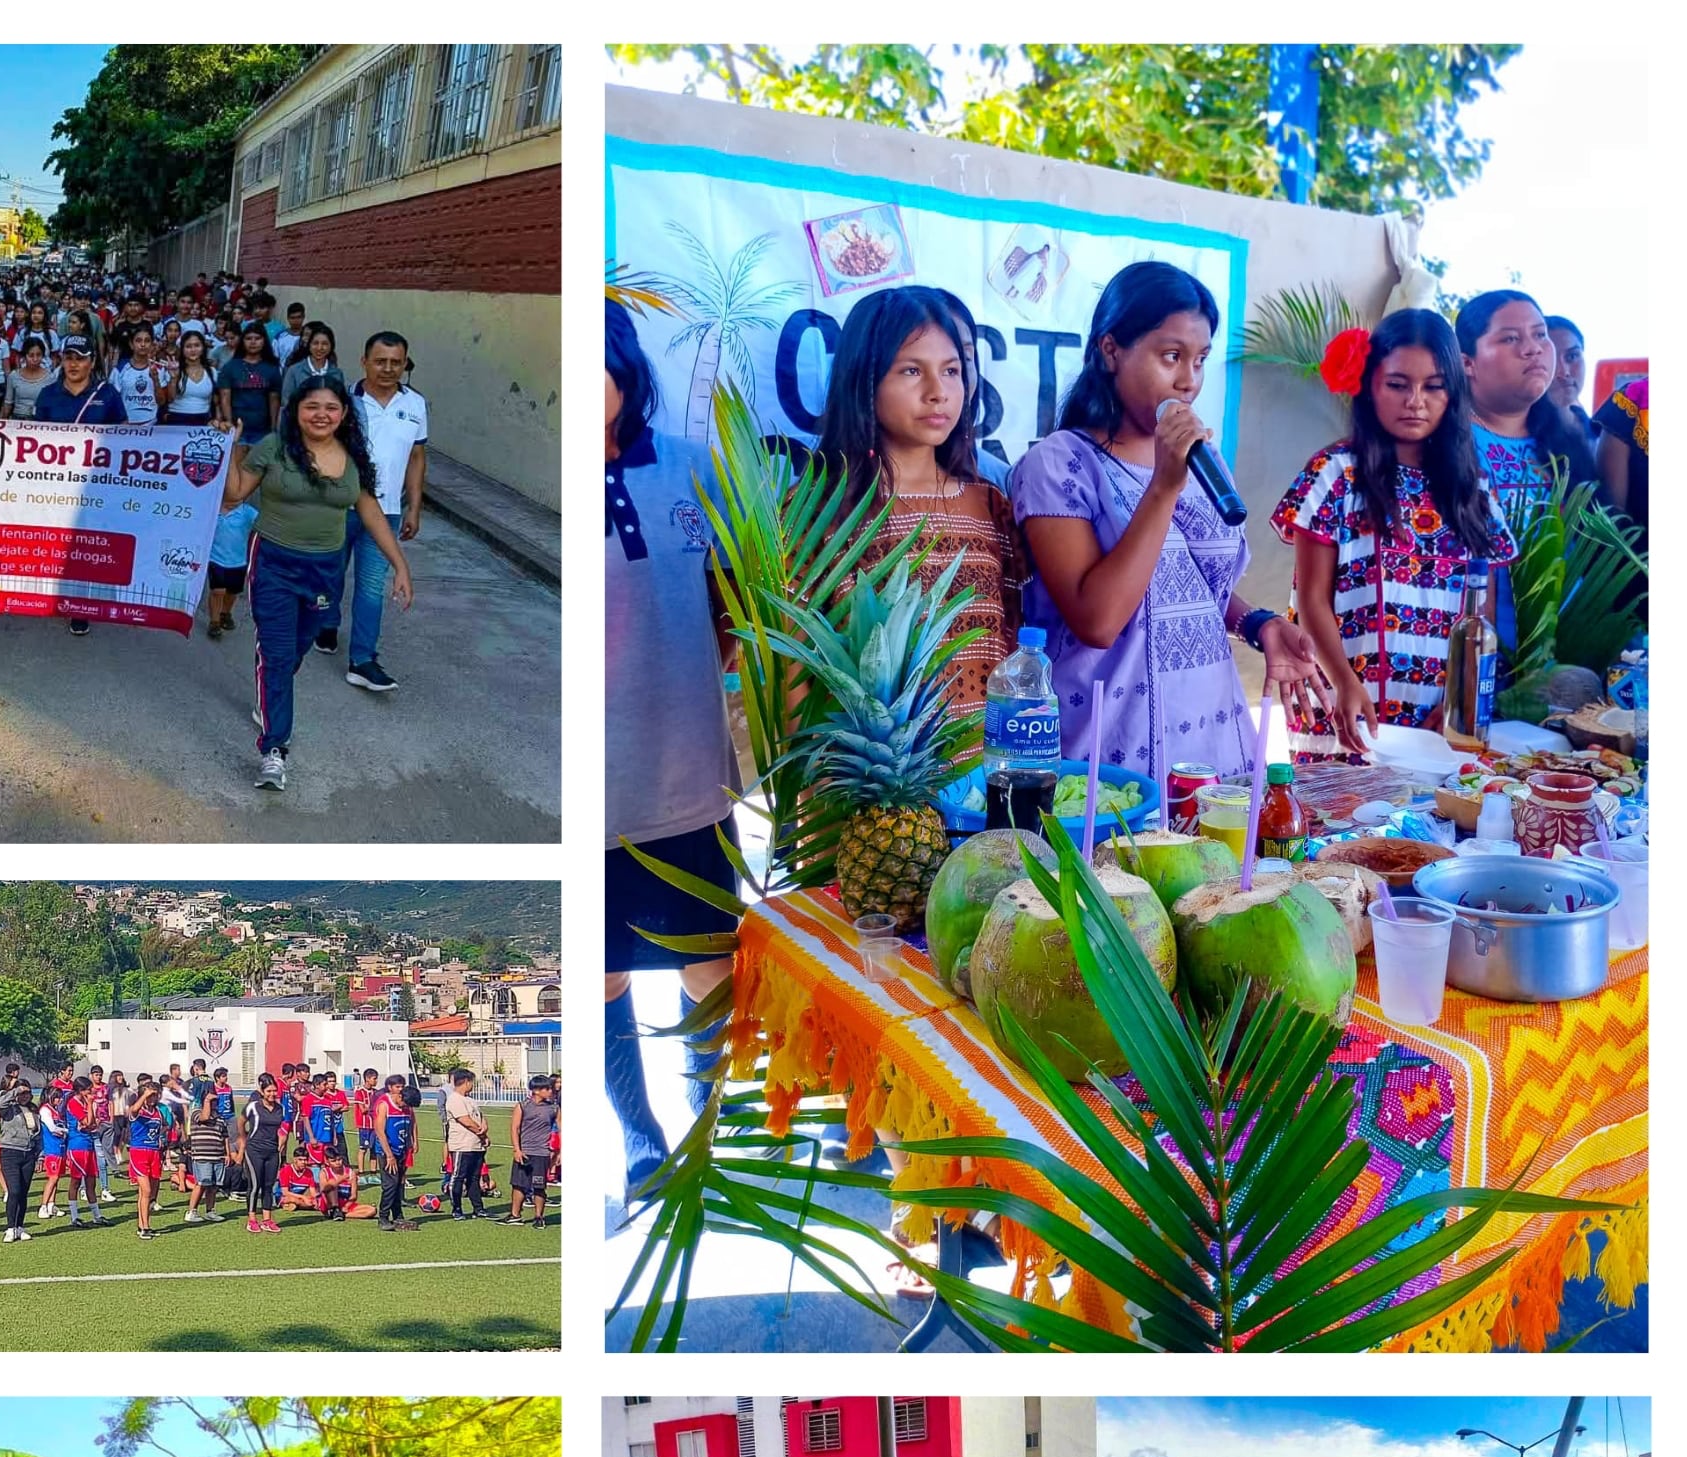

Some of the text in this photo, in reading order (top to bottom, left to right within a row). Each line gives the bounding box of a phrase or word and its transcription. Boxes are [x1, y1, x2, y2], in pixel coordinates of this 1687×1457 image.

[16, 421, 154, 438] Jornada Nacional
[15, 436, 181, 477] Por la paz
[5, 470, 168, 491] y contra las adicciones
[184, 463, 214, 483] 42
[0, 489, 141, 513] de noviembre de
[1, 528, 57, 542] fentanilo
[60, 531, 72, 543] te
[32, 546, 48, 558] de
[51, 547, 68, 559] las
[19, 562, 37, 574] ser
[39, 563, 65, 576] feliz
[371, 1041, 405, 1051] Vestiores
